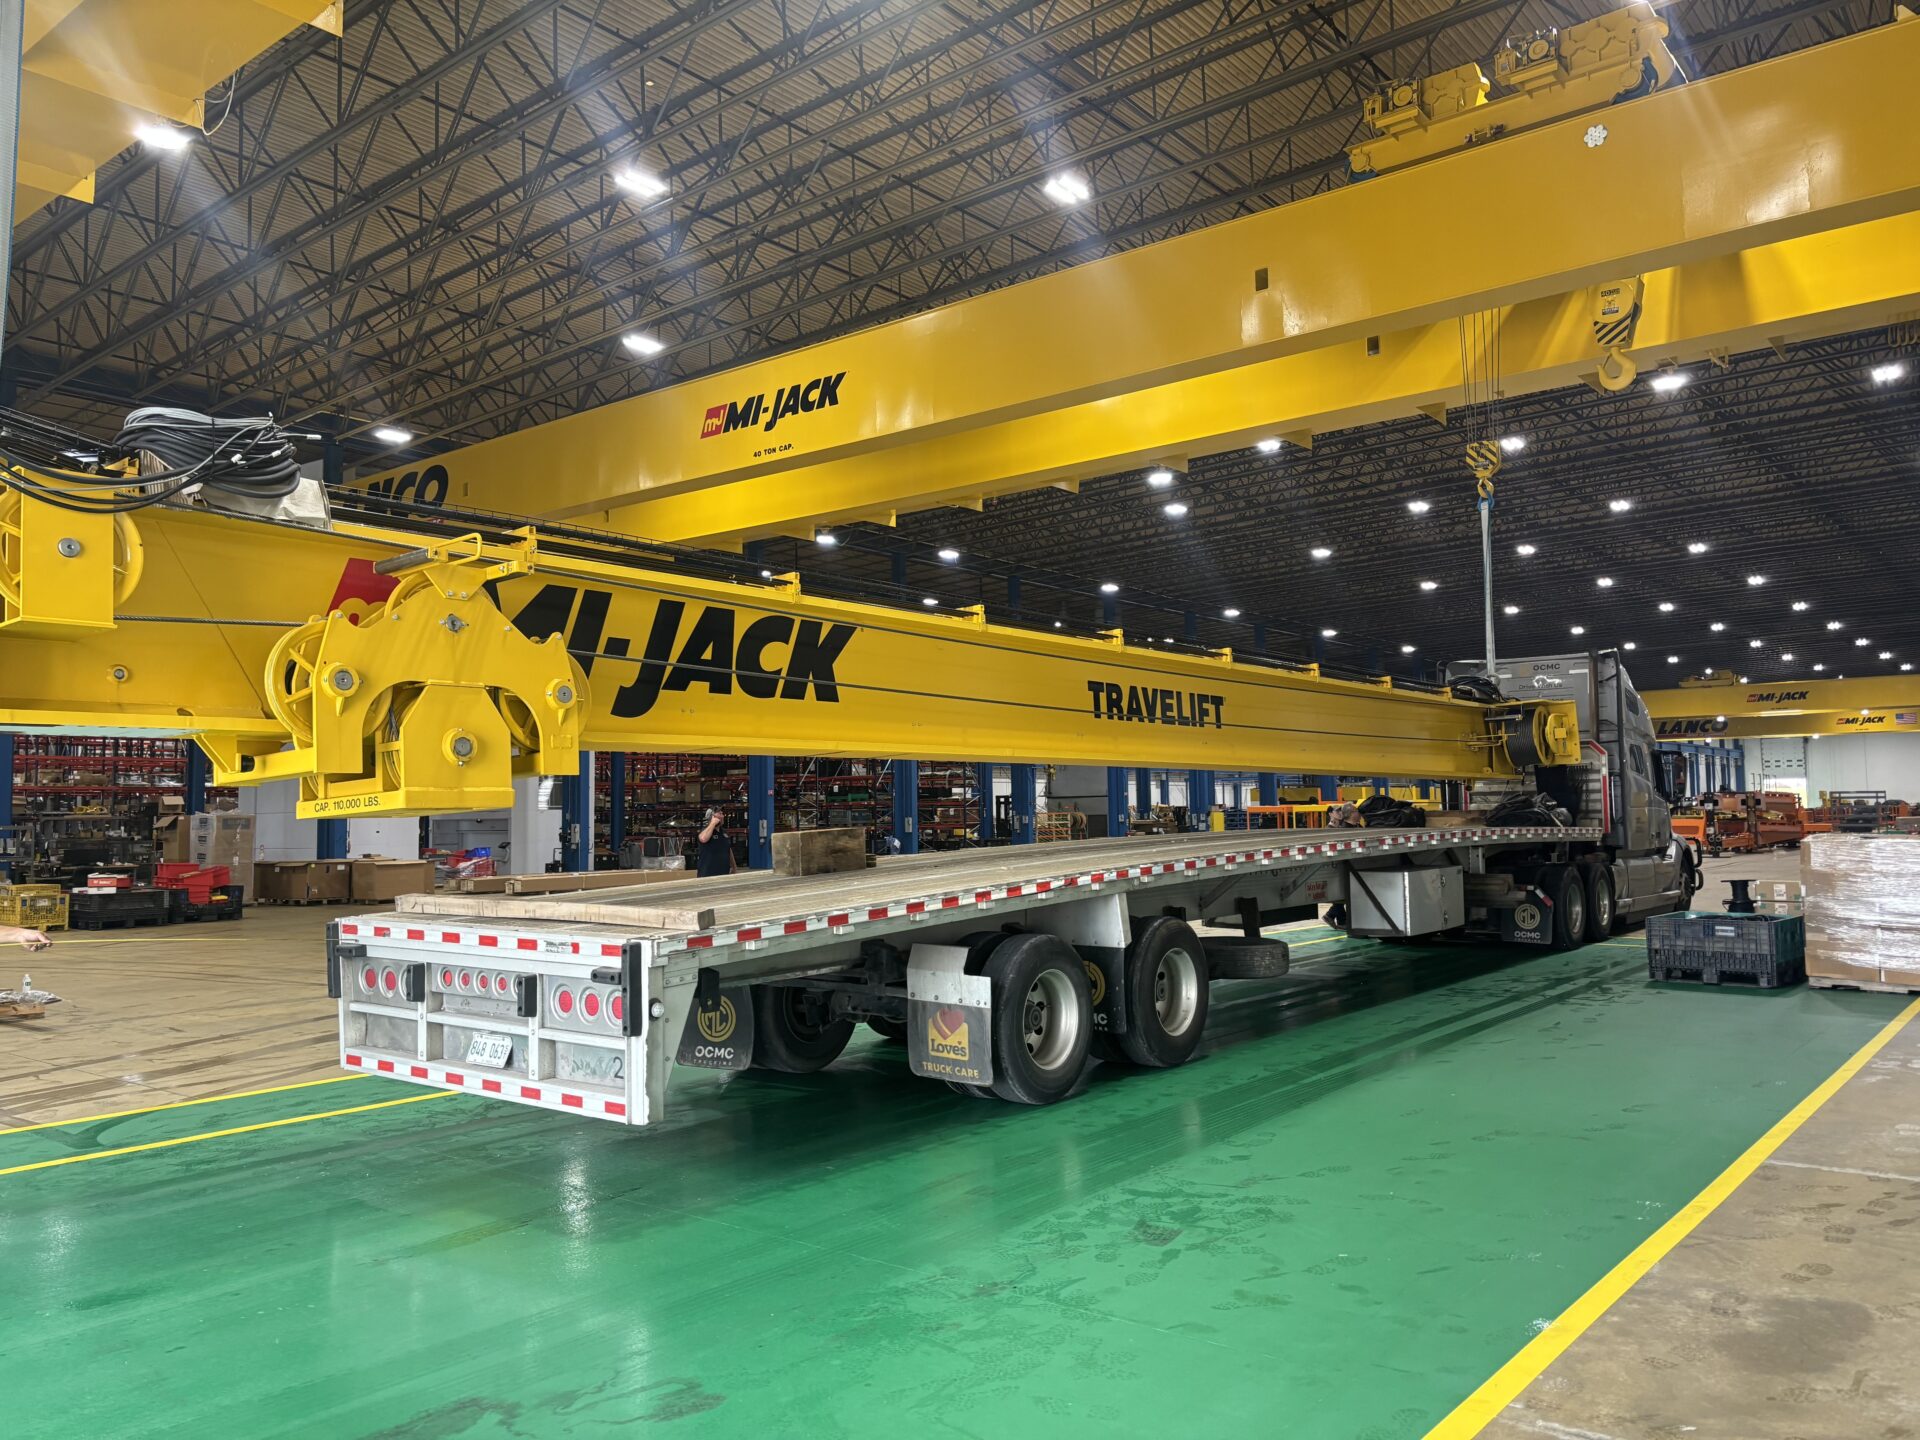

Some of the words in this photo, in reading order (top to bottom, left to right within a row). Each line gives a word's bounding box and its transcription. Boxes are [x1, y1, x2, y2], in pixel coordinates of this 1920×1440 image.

[722, 372, 847, 434] MI-JACK
[753, 450, 762, 458] 40
[764, 447, 777, 456] TON
[779, 443, 794, 452] CAP.
[1533, 663, 1561, 671] OCMC
[1087, 680, 1224, 729] TRAVELIFT
[1759, 691, 1810, 703] MI-JACK
[1657, 717, 1729, 735] LANCO
[1844, 716, 1886, 726] MI-JACK
[314, 802, 331, 813] CAP.
[333, 797, 361, 811] 110,000
[363, 796, 381, 807] LBS.
[1514, 931, 1541, 939] OCMC
[470, 1040, 488, 1057] 848
[695, 1045, 735, 1059] OCMC
[922, 1061, 953, 1075] TRUCK
[955, 1066, 980, 1079] CARE
